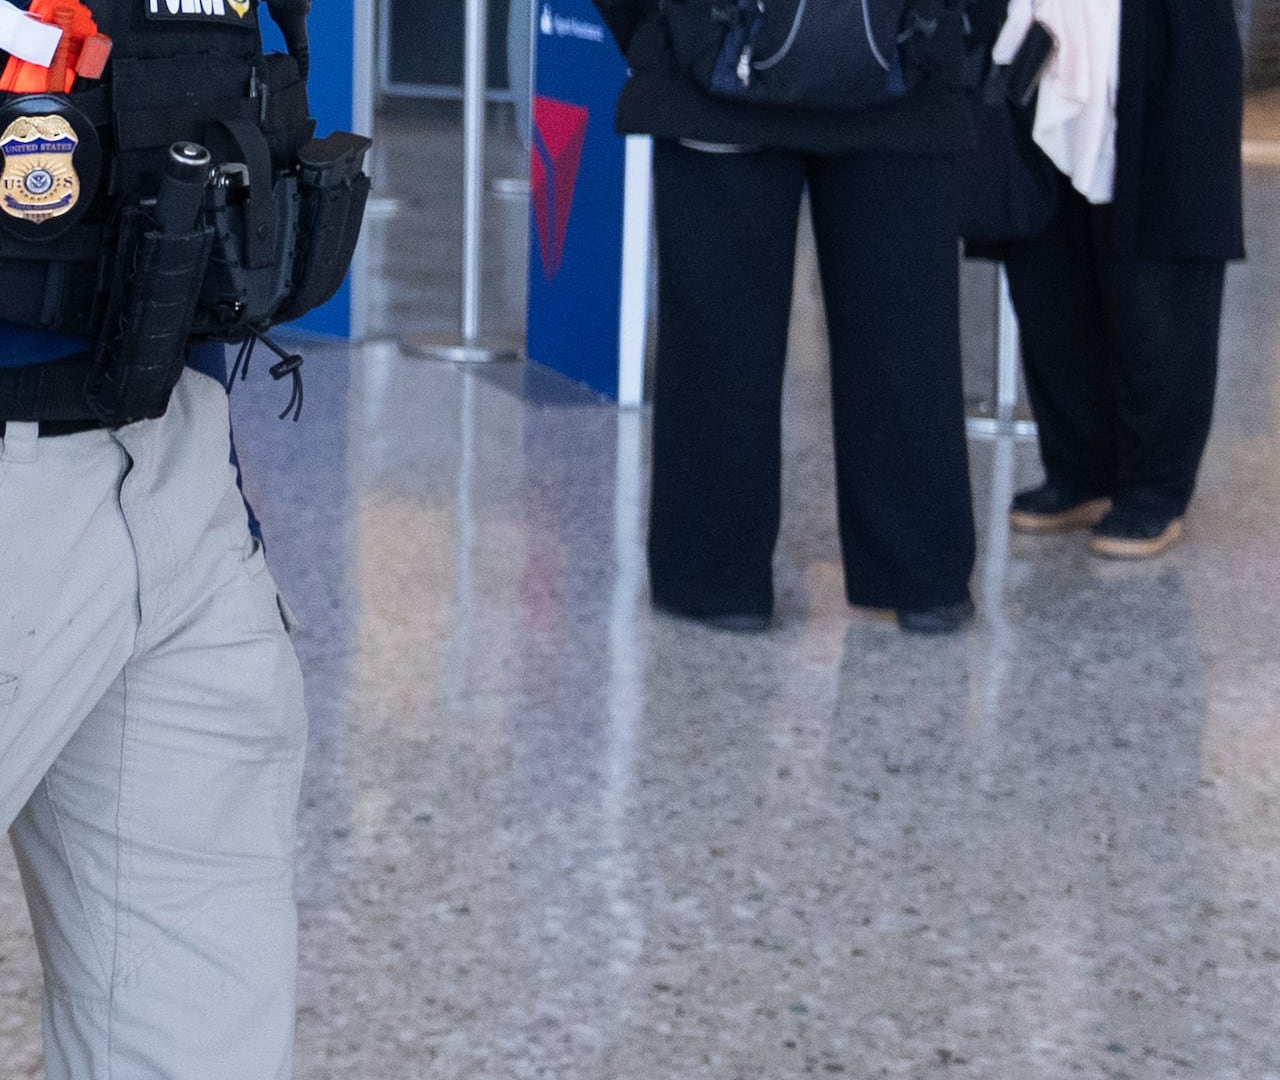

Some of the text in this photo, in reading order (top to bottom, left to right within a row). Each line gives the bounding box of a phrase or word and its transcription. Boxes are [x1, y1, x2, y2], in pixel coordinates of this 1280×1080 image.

[5, 142, 73, 153] UNITED STATES
[4, 176, 74, 190] U S
